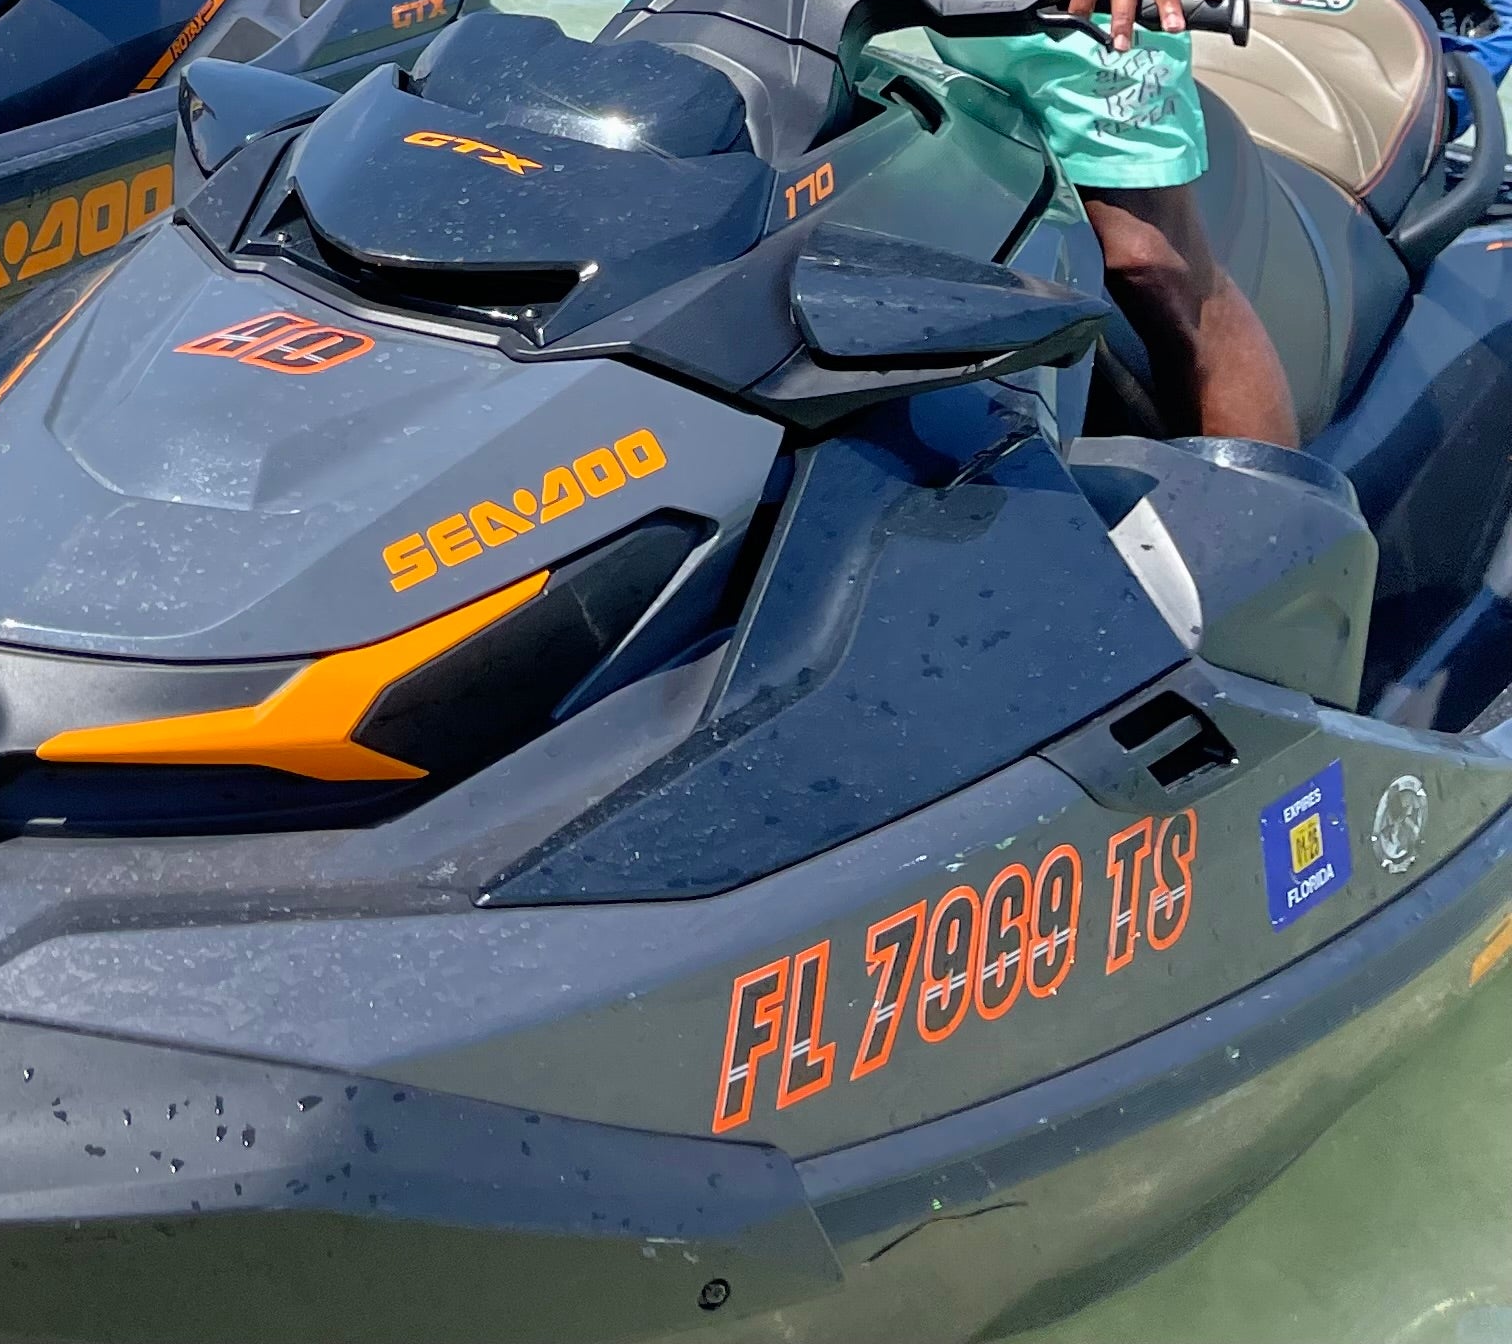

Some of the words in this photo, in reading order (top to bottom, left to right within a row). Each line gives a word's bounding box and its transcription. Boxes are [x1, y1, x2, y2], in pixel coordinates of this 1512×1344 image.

[403, 131, 543, 176] GTX
[785, 161, 835, 220] 170
[1283, 787, 1322, 823] EXPIRES
[1287, 863, 1335, 908] FLORIDA
[712, 939, 836, 1135] FL
[849, 843, 1084, 1082] 7969
[1105, 808, 1198, 976] TS
